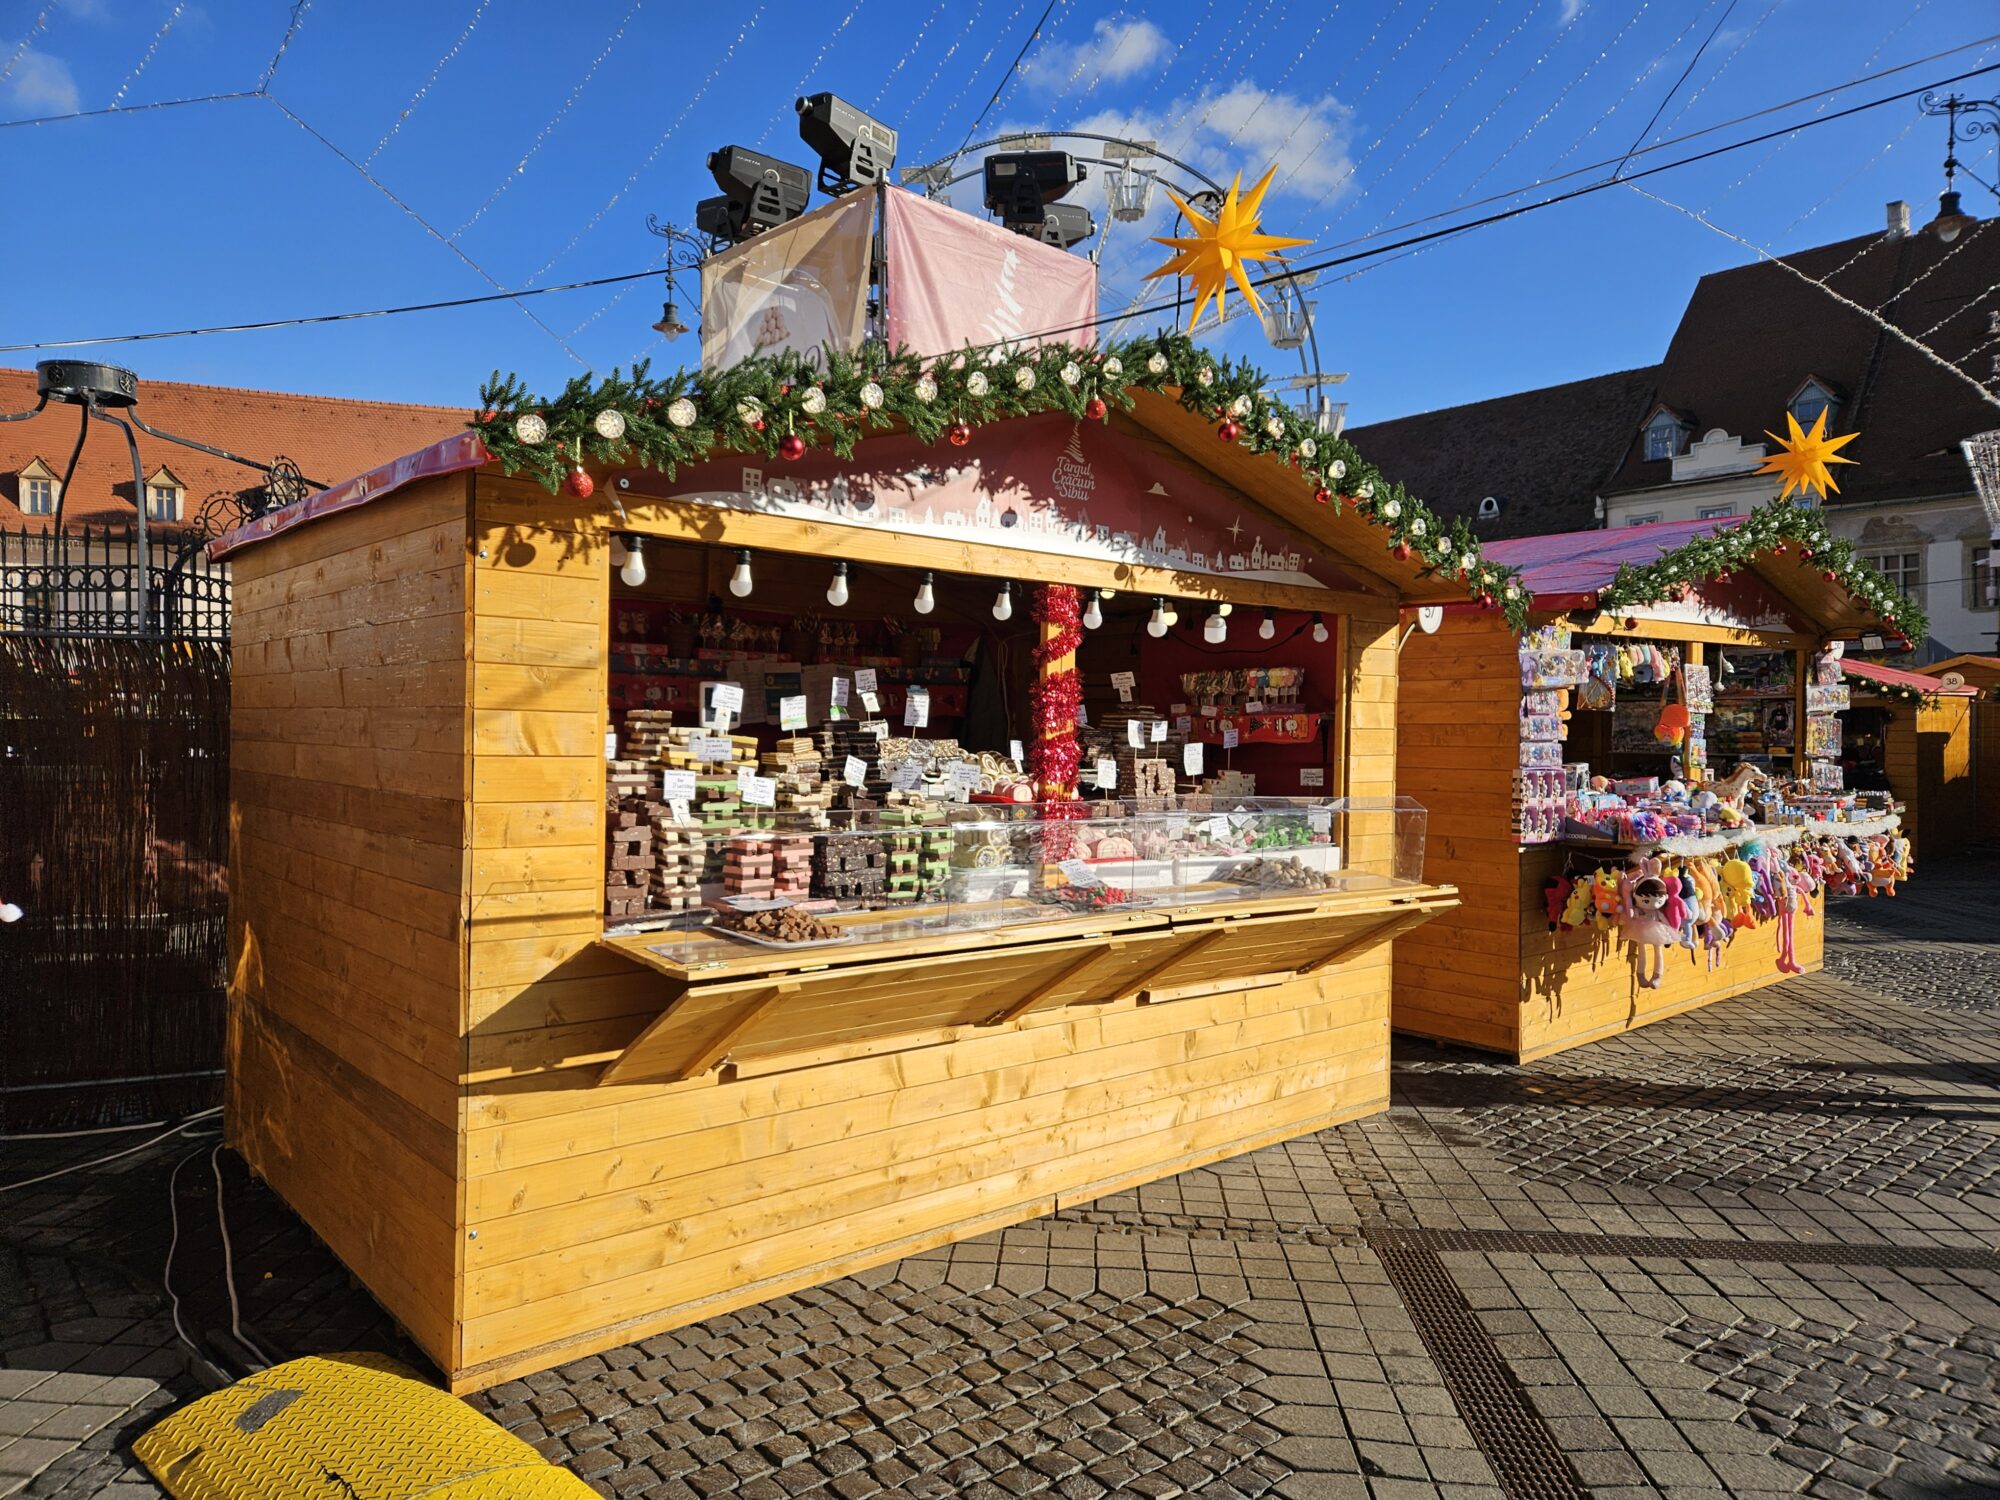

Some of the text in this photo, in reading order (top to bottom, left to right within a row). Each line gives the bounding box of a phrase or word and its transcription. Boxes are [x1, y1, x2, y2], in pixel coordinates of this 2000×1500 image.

[1057, 456, 1091, 478] Târgul
[1052, 467, 1096, 490] Crăciun
[1059, 483, 1089, 500] Sibiu
[1946, 677, 1958, 685] 38
